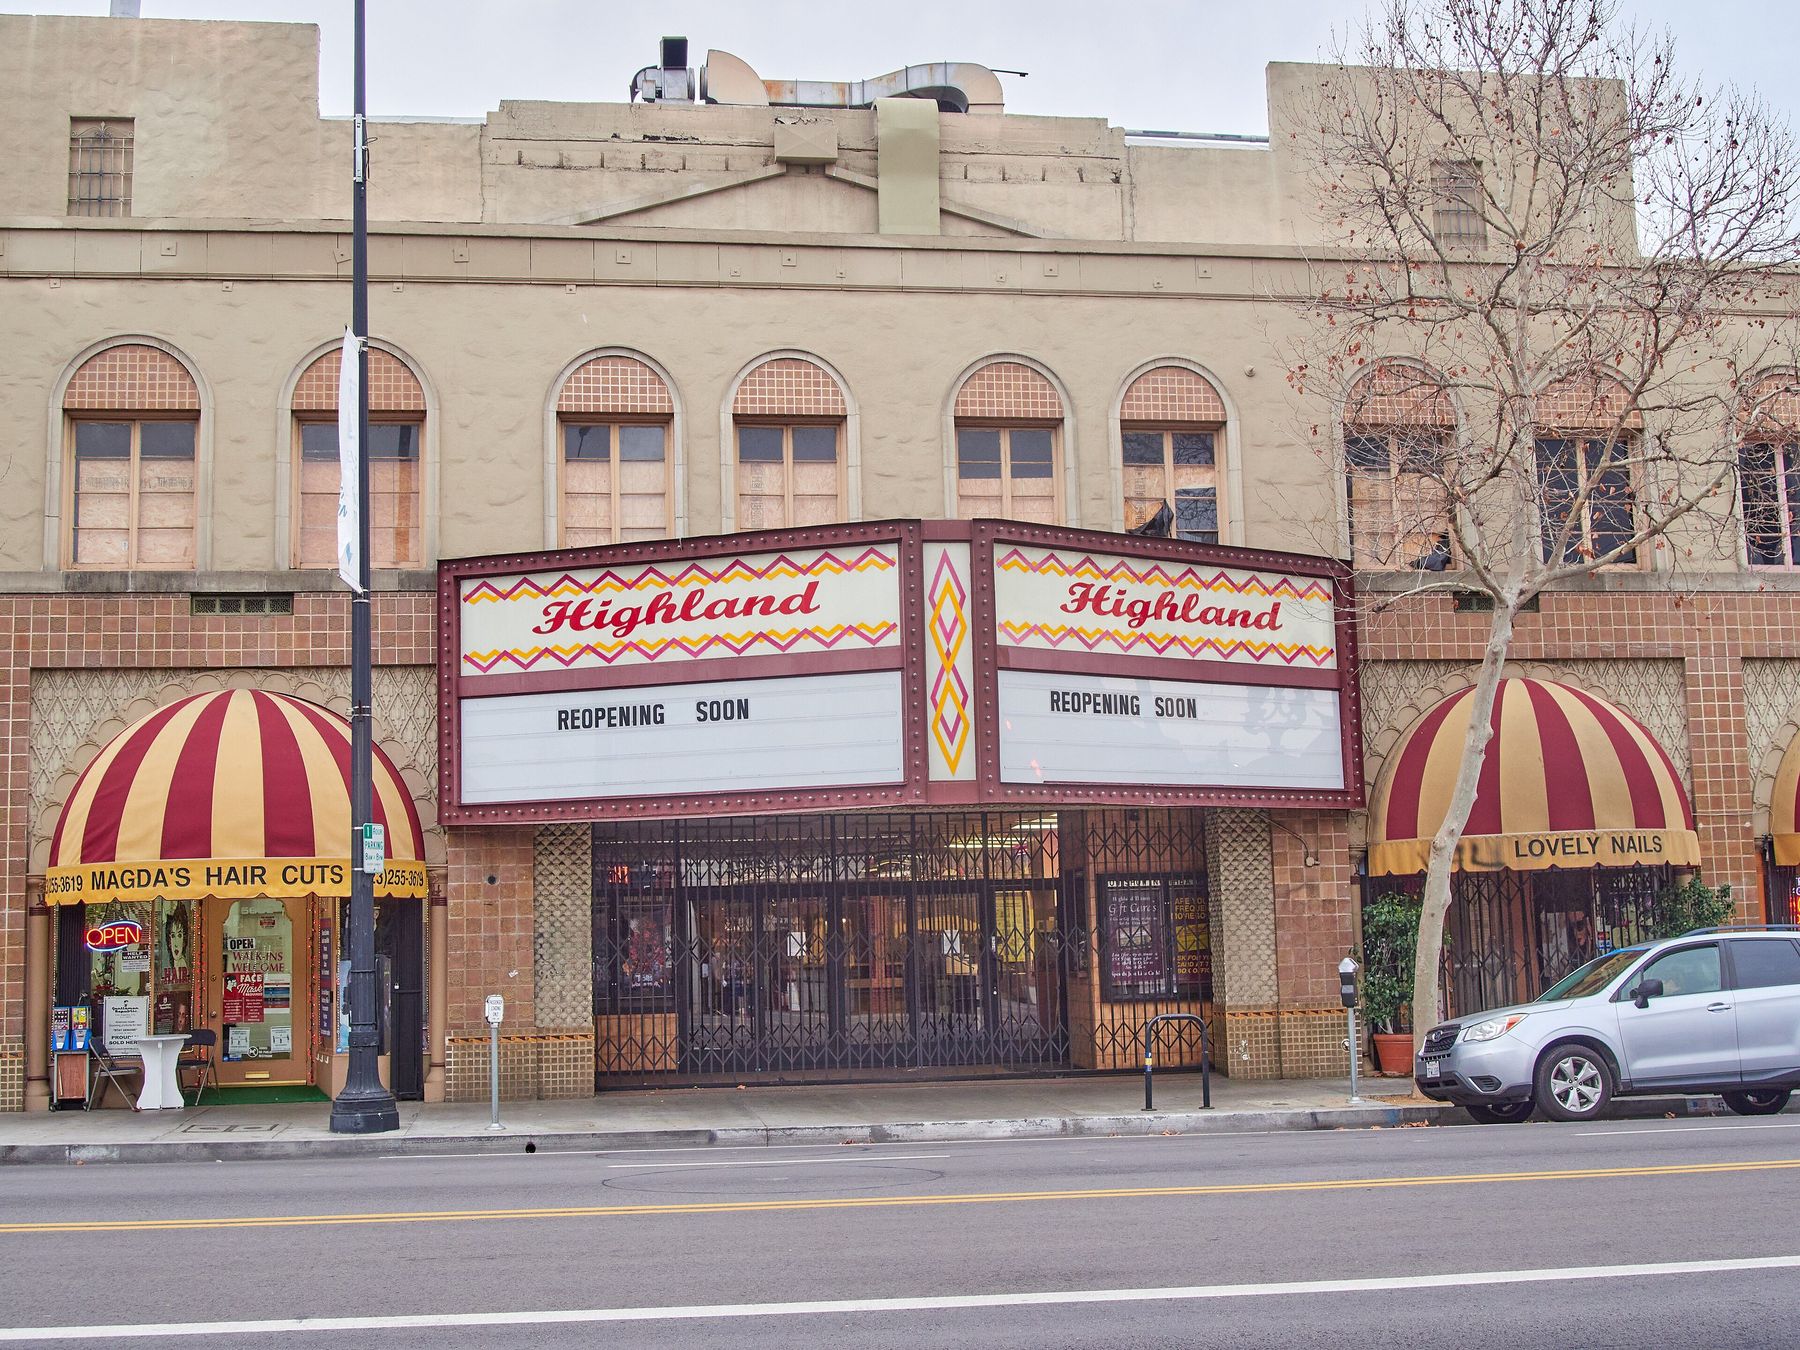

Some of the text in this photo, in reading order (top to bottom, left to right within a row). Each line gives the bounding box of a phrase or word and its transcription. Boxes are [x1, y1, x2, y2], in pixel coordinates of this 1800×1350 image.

[531, 581, 820, 638] Highland
[1059, 581, 1283, 631] Highland
[1050, 690, 1198, 719] REOPENING SOON
[557, 698, 749, 731] REOPENING SOON
[1515, 836, 1600, 857] LOVELY
[1611, 835, 1662, 854] NAILS
[91, 867, 191, 891] MAGDA'S
[205, 866, 267, 886] HAIR
[281, 864, 343, 885] CUTS
[1108, 902, 1127, 915] Gft
[86, 927, 140, 946] OPEN
[229, 938, 254, 949] OPEN
[232, 951, 284, 961] WALK-INS
[163, 967, 188, 984] HAIR
[231, 963, 285, 973] WELCOME
[240, 974, 262, 983] FACE
